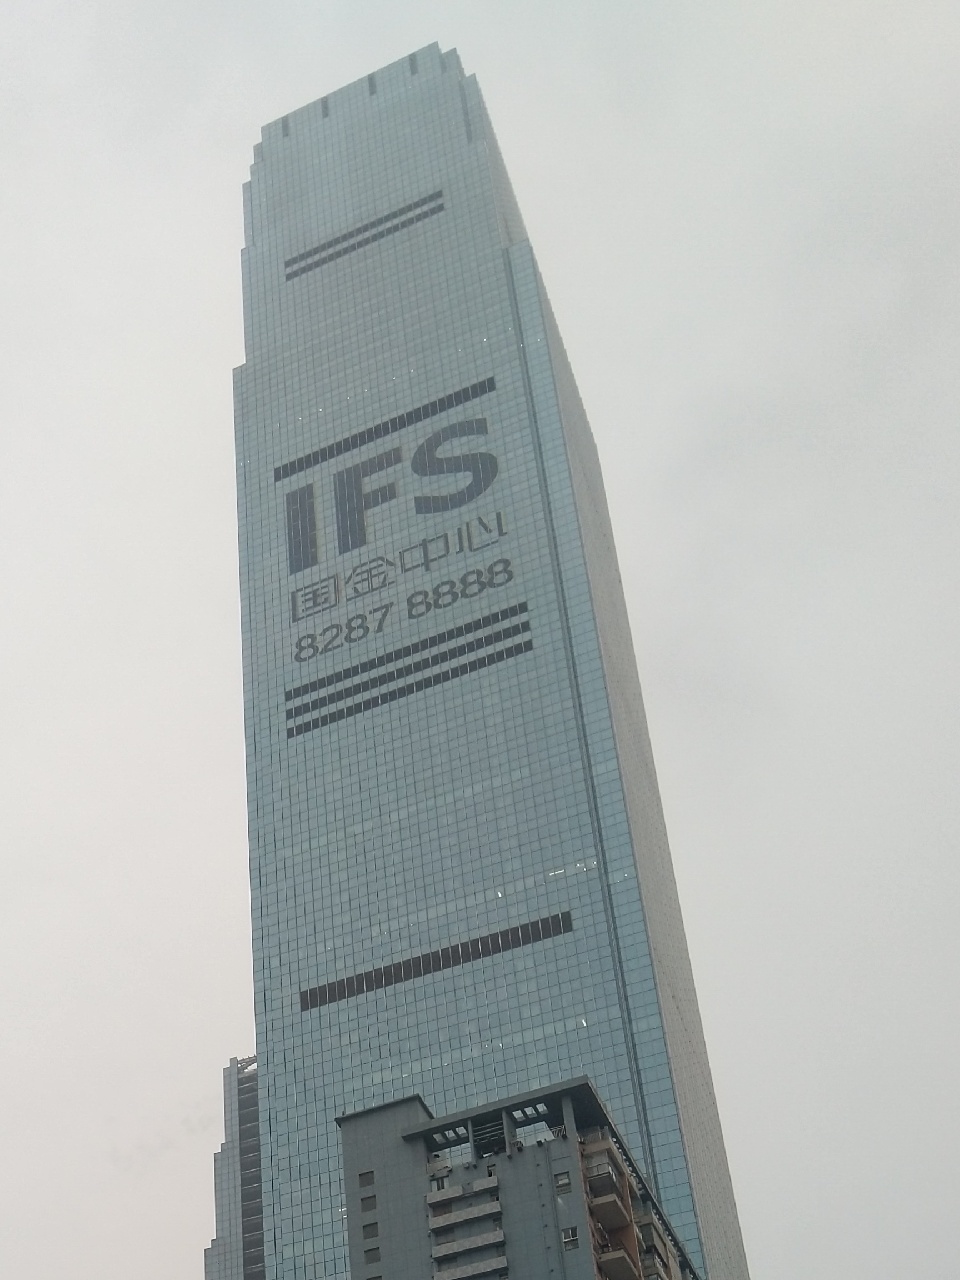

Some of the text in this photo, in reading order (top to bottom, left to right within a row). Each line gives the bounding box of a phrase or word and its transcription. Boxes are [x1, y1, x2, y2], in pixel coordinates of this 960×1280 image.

[286, 418, 498, 575] IFS
[291, 511, 507, 623] 国金中心
[294, 558, 514, 662] 8287 8888
